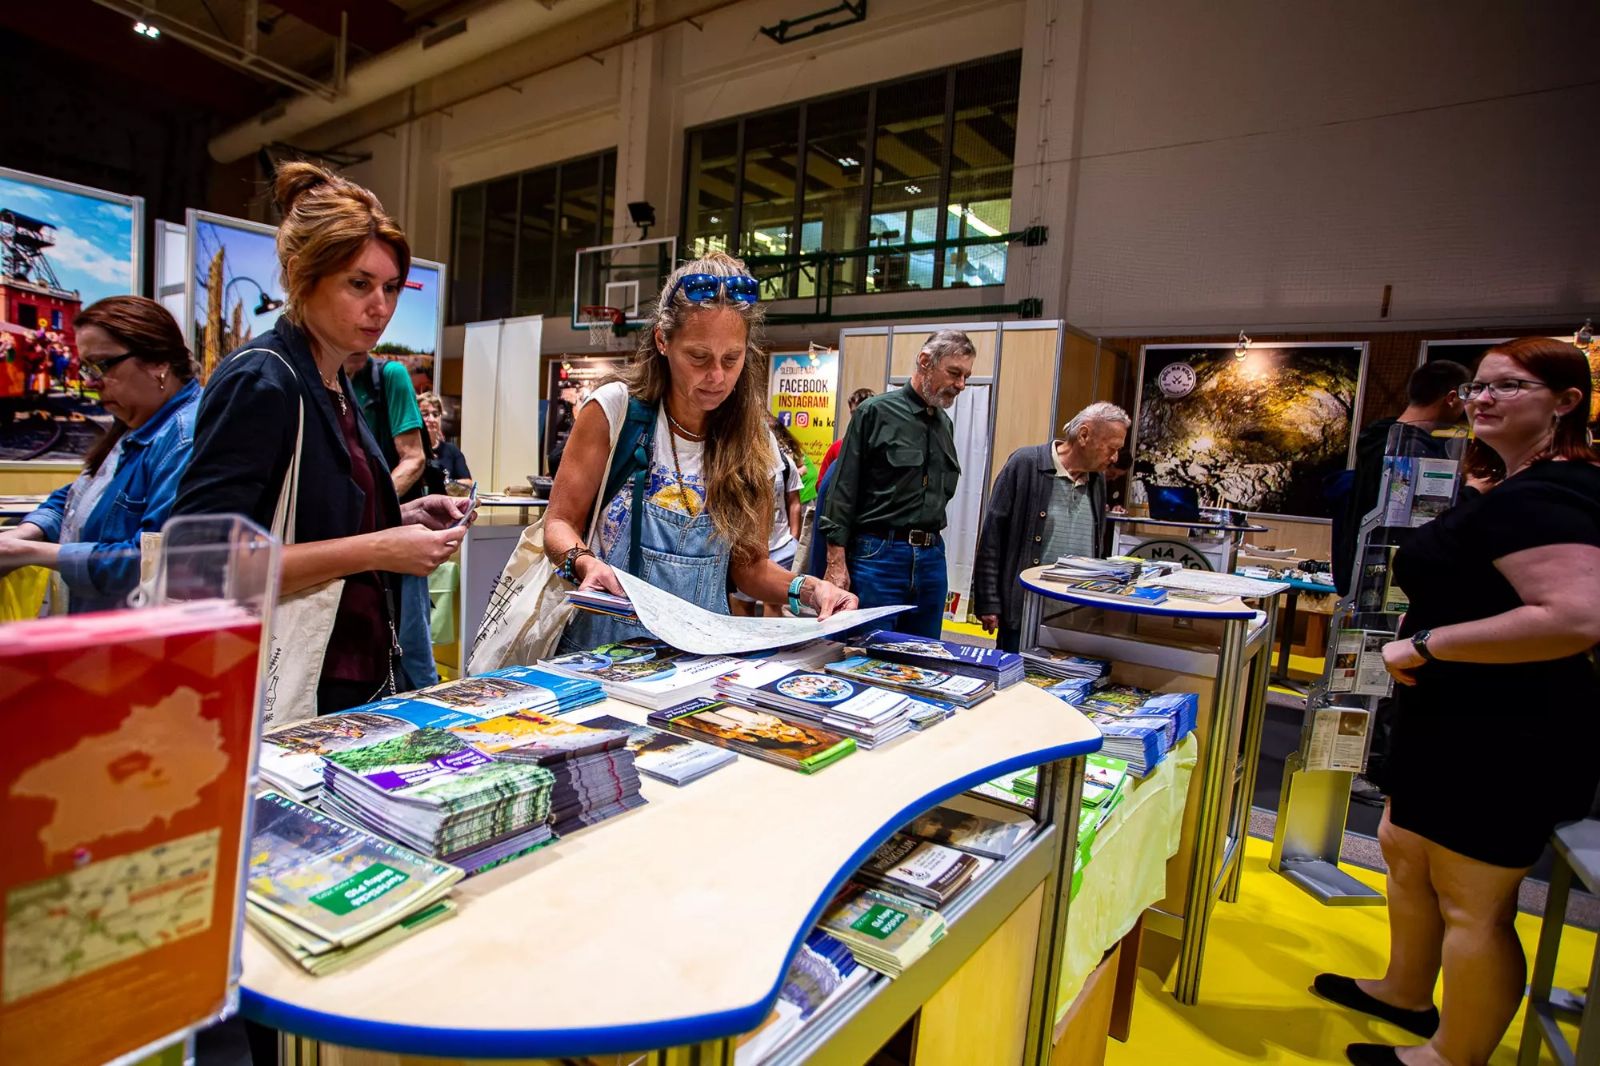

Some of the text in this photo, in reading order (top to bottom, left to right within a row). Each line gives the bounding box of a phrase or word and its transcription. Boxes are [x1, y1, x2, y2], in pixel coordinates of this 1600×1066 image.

[779, 379, 828, 393] FACEBOOK
[778, 395, 829, 409] INSTAGRAM!
[812, 417, 823, 427] Na
[1151, 547, 1175, 559] NA
